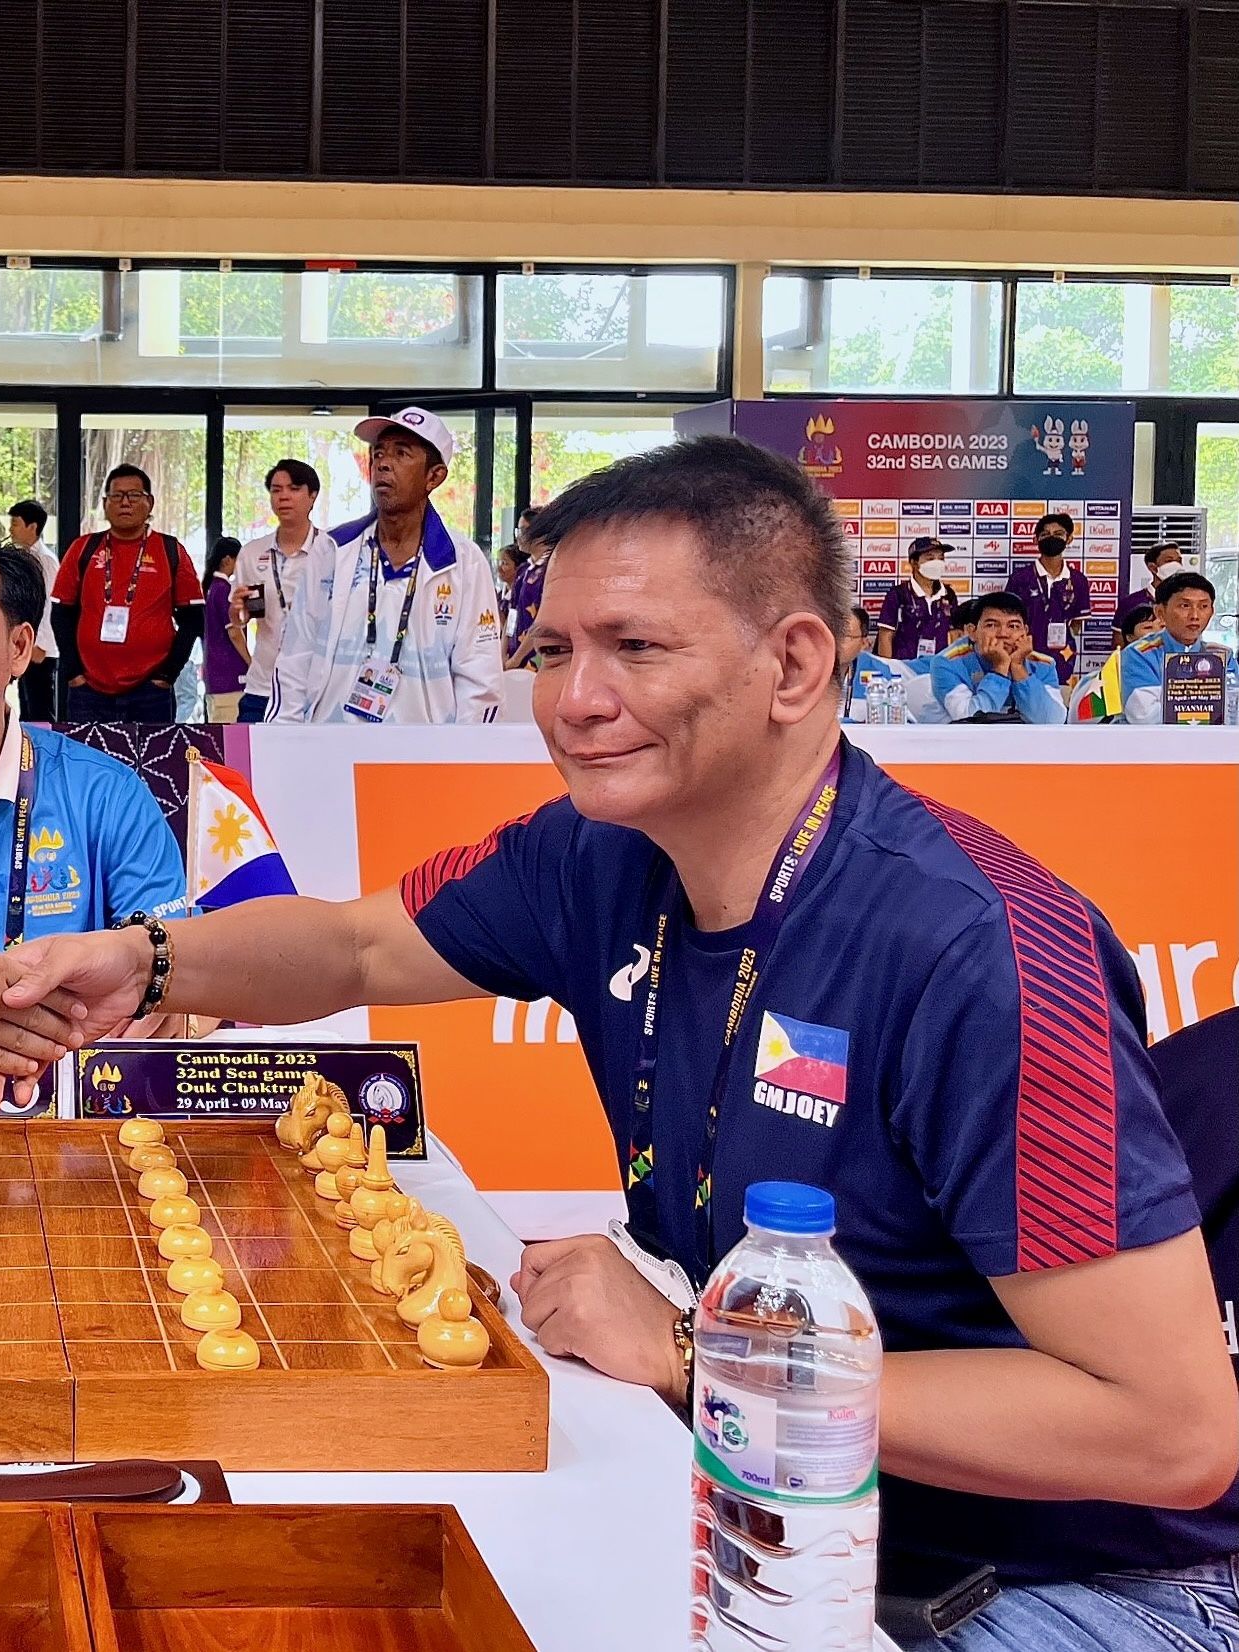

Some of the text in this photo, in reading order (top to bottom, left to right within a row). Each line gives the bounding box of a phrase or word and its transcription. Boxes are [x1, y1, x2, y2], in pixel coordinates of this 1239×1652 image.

[868, 433, 1008, 450] CAMBODIA 2023
[867, 454, 1008, 470] 32nd SEA GAMES
[980, 504, 1004, 514] AIA
[868, 562, 892, 572] AIA
[1090, 582, 1112, 592] AIA
[812, 786, 838, 818] PEACE
[804, 815, 822, 831] IN
[792, 830, 813, 855] LIVE
[656, 913, 667, 948] PEACE
[653, 950, 661, 962] IN
[649, 965, 660, 988] LIVE
[724, 947, 757, 1046] CAMBODIA 2023
[176, 1053, 317, 1066] Cambodia 2023
[176, 1068, 222, 1080] 32nd
[226, 1068, 259, 1080] Sea
[176, 1082, 306, 1094] Ouk Chaktra
[176, 1098, 192, 1109] 29
[195, 1098, 230, 1111] April
[241, 1098, 257, 1109] 09
[261, 1098, 290, 1112] May
[741, 1470, 770, 1486] 700ml
